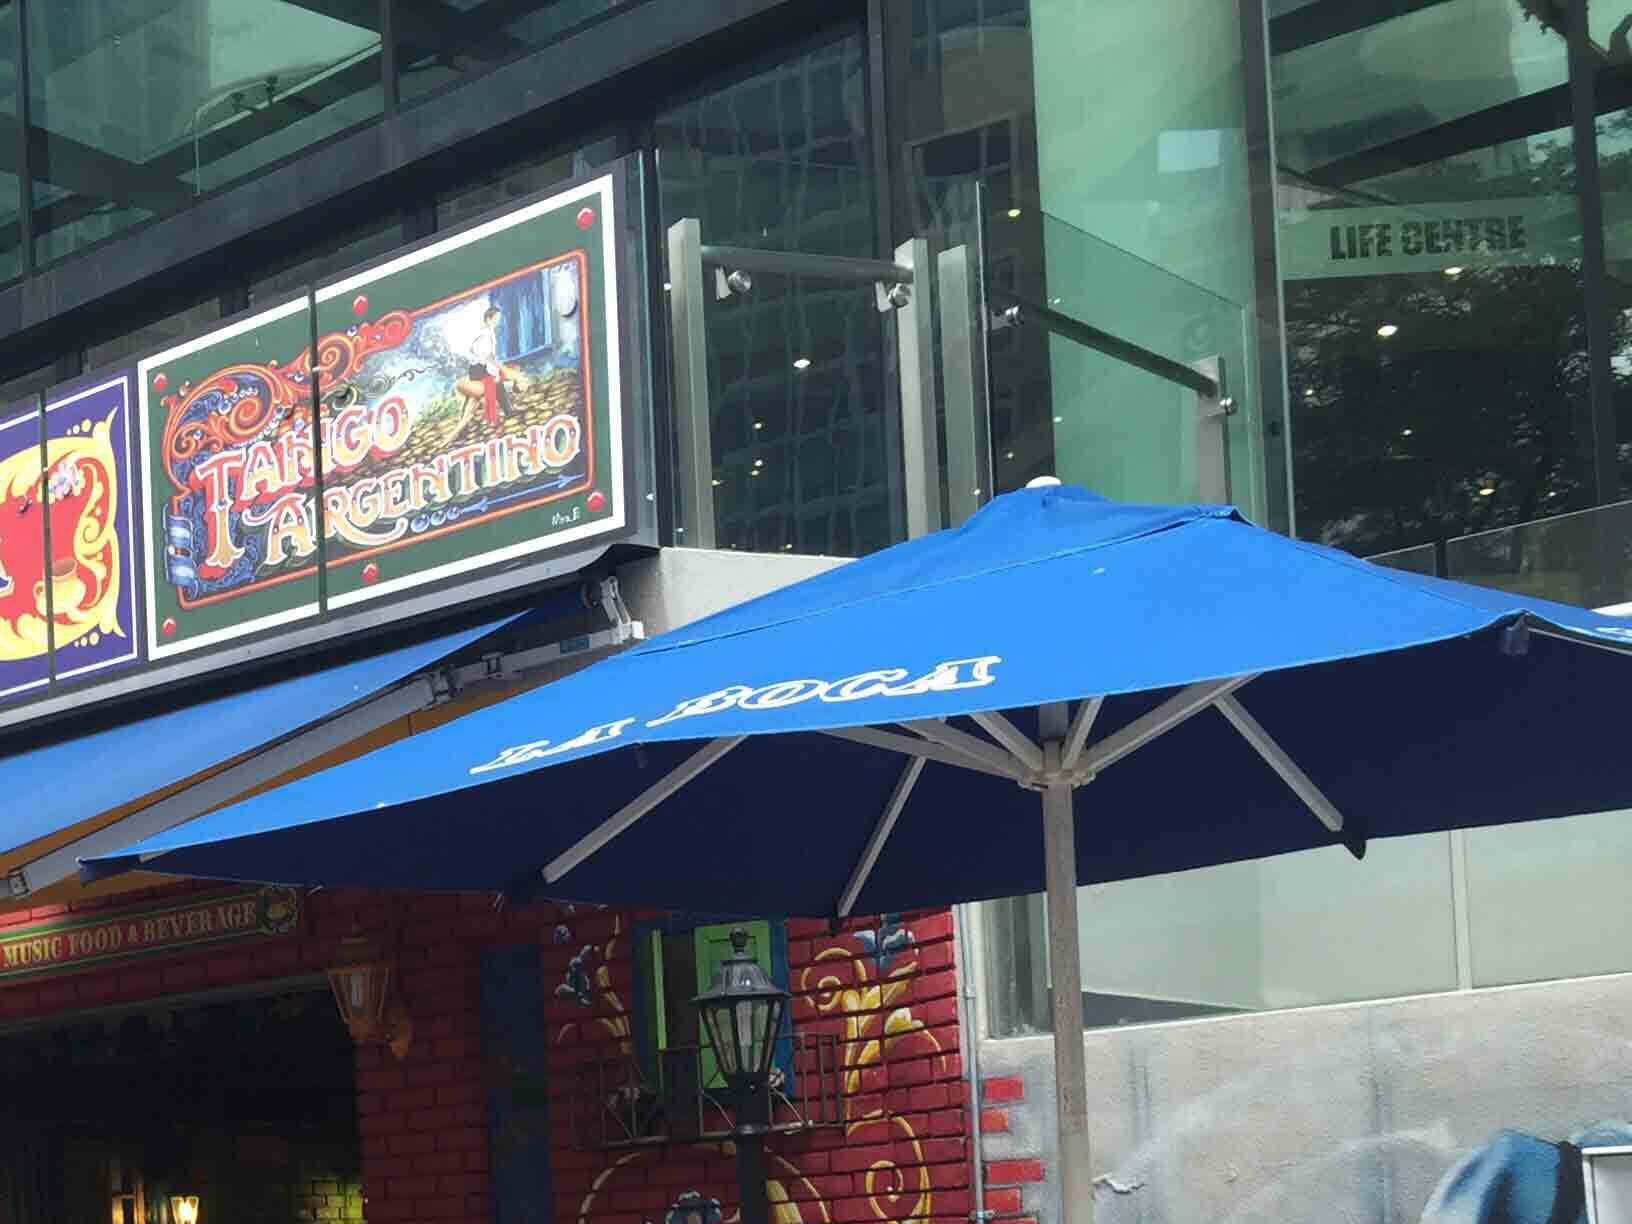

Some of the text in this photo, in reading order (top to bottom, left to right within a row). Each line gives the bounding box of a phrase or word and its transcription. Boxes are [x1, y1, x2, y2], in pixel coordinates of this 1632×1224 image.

[1330, 215, 1528, 261] LIFE CENTRE
[195, 396, 413, 567] TANGO
[243, 414, 583, 567] ARGENTINO
[647, 656, 1001, 727] BOCA
[2, 935, 64, 970] MUSIC
[68, 926, 121, 958] FOOD
[127, 926, 137, 943] &
[144, 900, 257, 942] BEVERAGE
